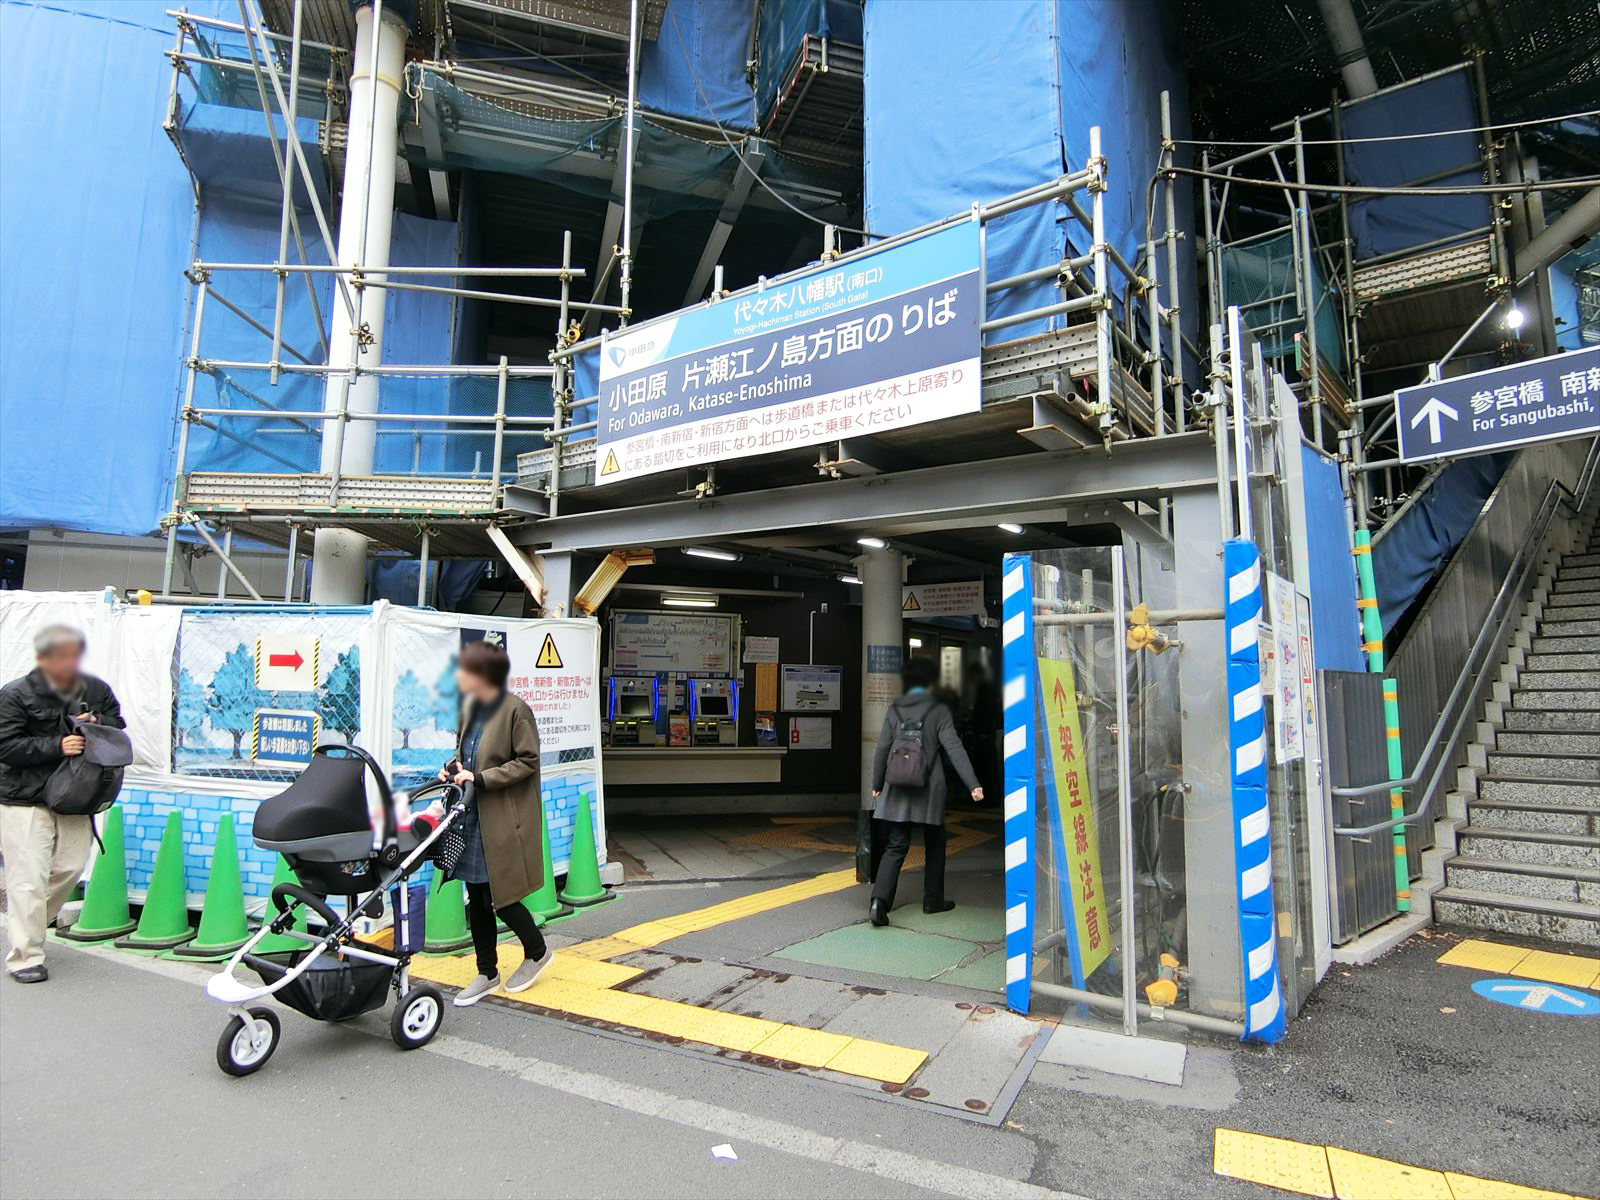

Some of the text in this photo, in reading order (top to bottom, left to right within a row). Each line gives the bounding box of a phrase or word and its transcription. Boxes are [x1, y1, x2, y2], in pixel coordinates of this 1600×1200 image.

[733, 290, 869, 336] Yoyogi-Hachiman Station (South Gate)
[608, 287, 959, 413] 小田原 片瀬江ノ島方面のりば
[608, 372, 812, 434] For Odawara, Katase-Enoshima
[1470, 378, 1544, 416] 参宮橋
[1472, 397, 1595, 432] For Sangubashi,
